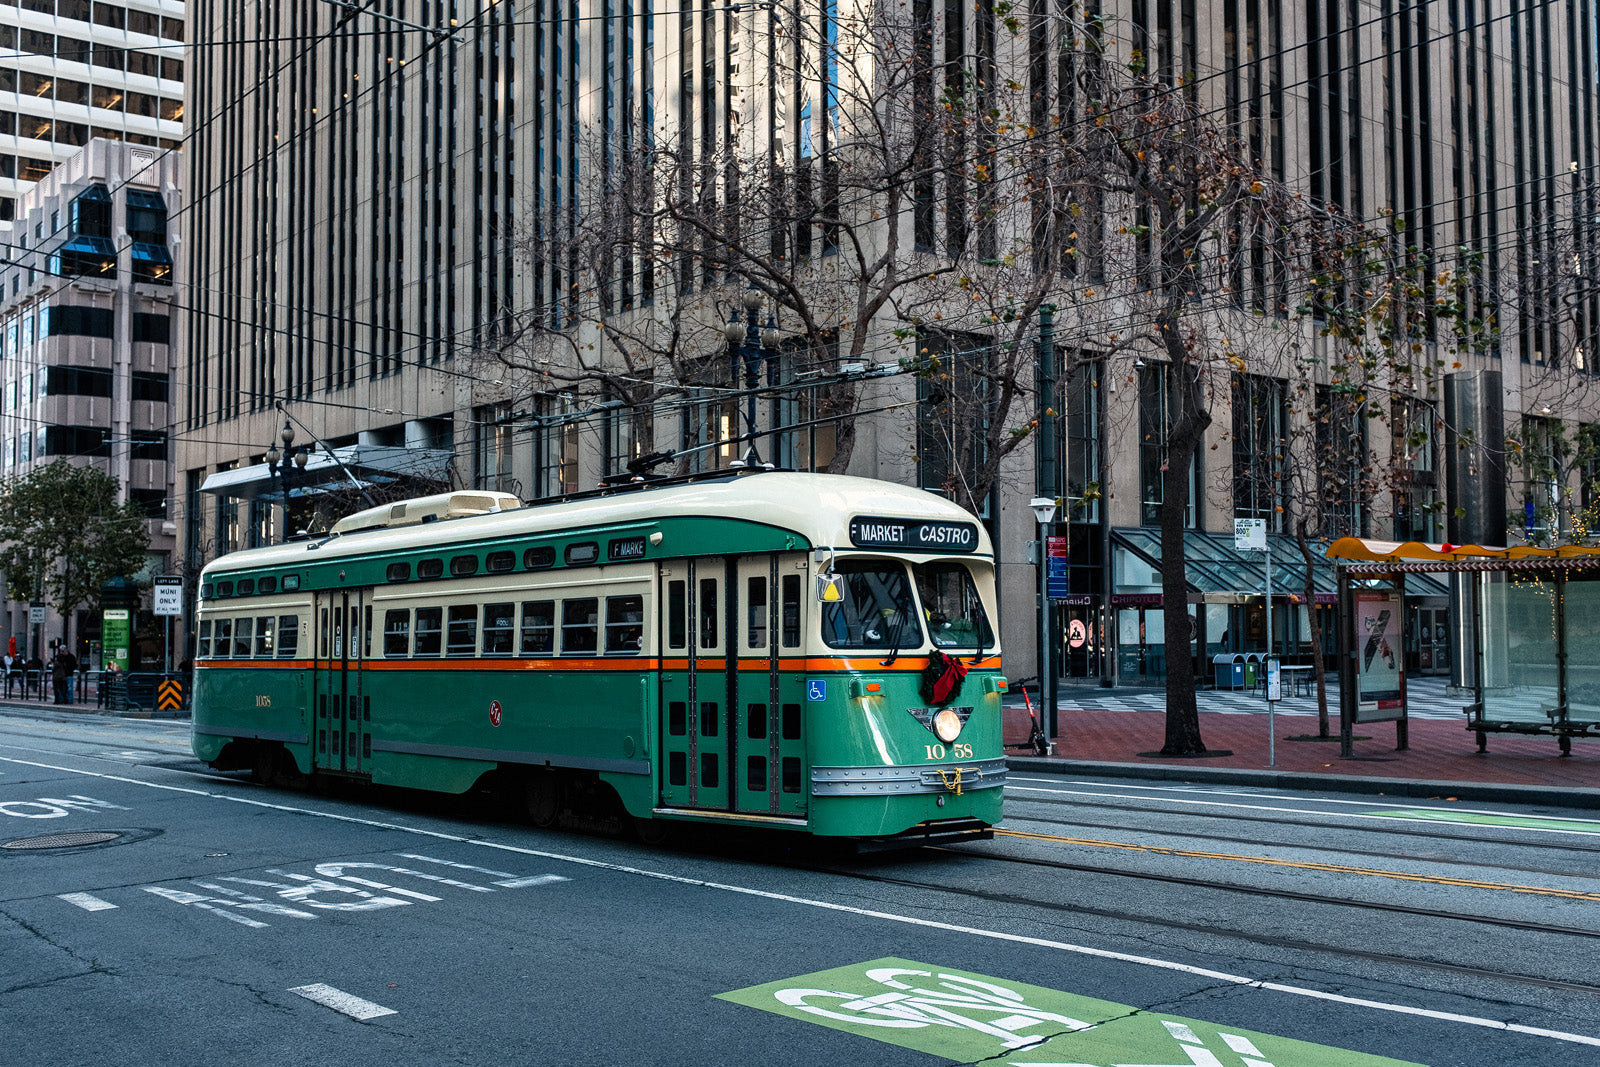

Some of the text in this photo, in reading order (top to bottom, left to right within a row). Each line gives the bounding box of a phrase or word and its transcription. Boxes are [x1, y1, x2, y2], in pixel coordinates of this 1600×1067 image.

[860, 524, 905, 542] MARKET
[919, 525, 970, 545] CASTRO
[614, 540, 644, 556] F MARKE
[1111, 595, 1160, 604] CHIPOTLE
[255, 695, 272, 708] 1058
[490, 702, 501, 724] CTA
[138, 853, 576, 929] TURN
